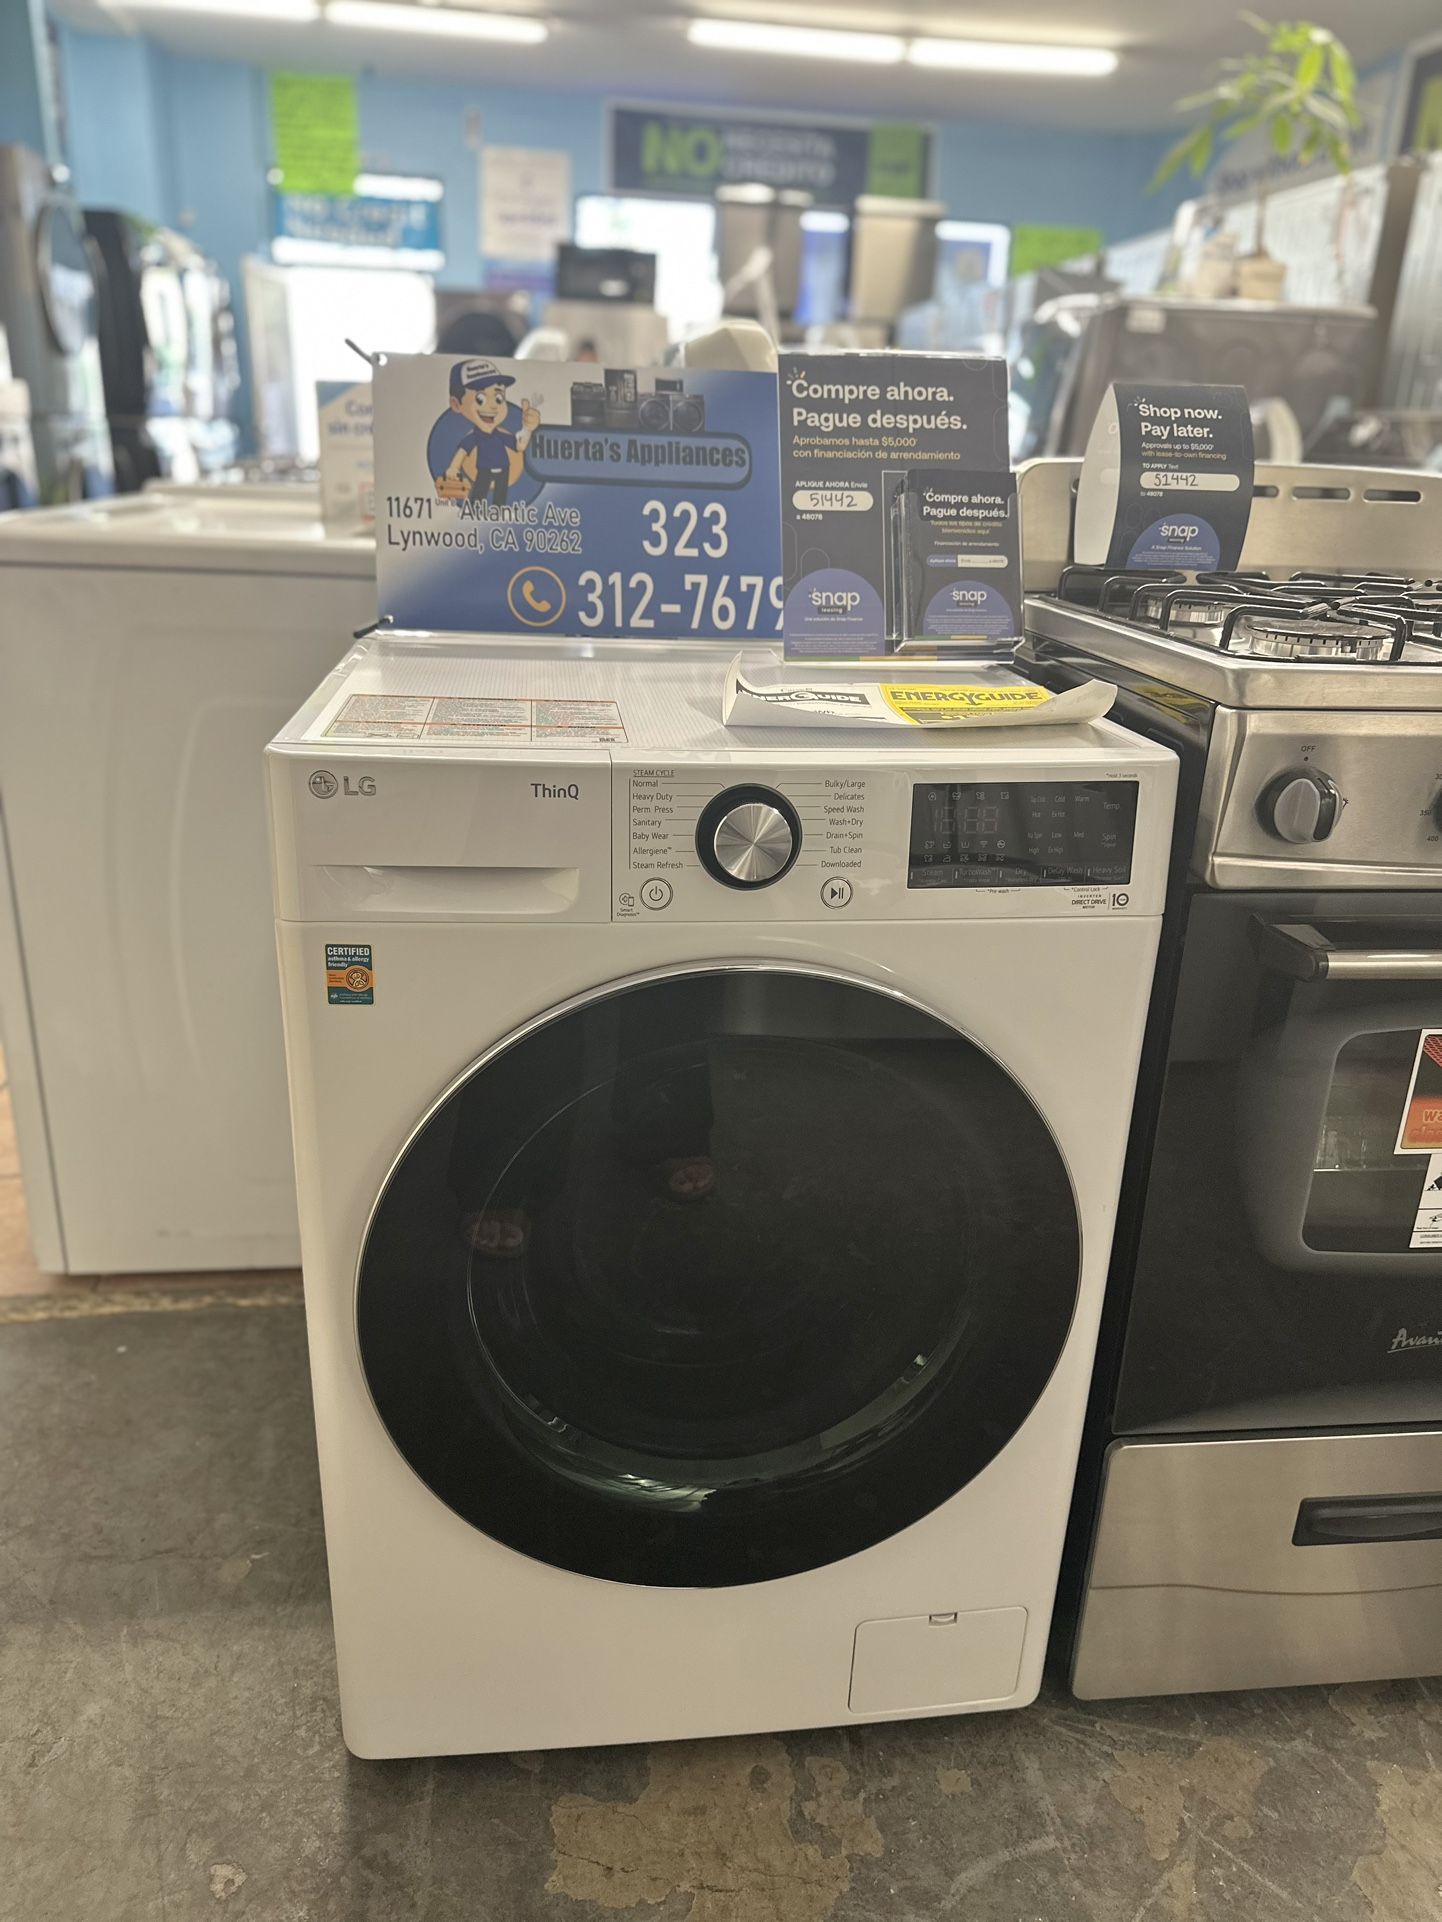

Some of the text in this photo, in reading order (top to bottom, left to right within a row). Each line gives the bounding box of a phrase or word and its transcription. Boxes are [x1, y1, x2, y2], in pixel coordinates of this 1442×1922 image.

[642, 121, 722, 177] NO
[791, 378, 955, 404] Compre ahora.
[1138, 404, 1222, 420] Shop now.
[792, 408, 968, 433] Pague después.
[1140, 422, 1213, 439] Pay later.
[792, 435, 850, 447] Aprobamos
[852, 436, 880, 446] hasta
[1141, 442, 1172, 450] Approvals
[532, 434, 748, 468] Huerta's Appliances
[793, 448, 961, 461] con financiación de arrendamiento
[1198, 452, 1226, 460] financing
[795, 480, 824, 488] APLIQUE
[825, 480, 850, 488] AHORA
[1154, 473, 1199, 487] 51442
[809, 492, 858, 508] 51442
[925, 492, 1005, 505] Compre ahora.
[386, 496, 432, 520] 11671
[459, 501, 538, 526] Atlantic
[542, 504, 580, 527] Ave
[923, 506, 1008, 520] Pague después.
[642, 500, 729, 559] 323
[1160, 524, 1198, 541] snap
[387, 524, 582, 554] Lynwood, CA 90262
[577, 570, 783, 631] 312-7679
[811, 590, 860, 612] snap
[952, 590, 987, 606] snap
[890, 691, 1043, 706] ENERGYGUIDE
[343, 776, 376, 797] LG
[632, 780, 658, 788] Normal
[824, 780, 866, 790] Bulky/Large
[530, 783, 580, 800] ThinQ
[632, 792, 673, 802] Heavy Duty
[834, 792, 865, 800] Delicates
[654, 806, 674, 814] Press
[824, 805, 864, 814] Speed Wash
[1104, 802, 1120, 812] Temp
[632, 818, 662, 828] Sanitary
[828, 818, 864, 828] Wash+Dry
[632, 832, 669, 841] Baby Wear
[826, 832, 864, 840] Drain+Spin
[1102, 833, 1117, 842] Spin
[632, 862, 684, 870] Steam Refresh
[821, 860, 862, 868] Downloaded
[1112, 893, 1130, 907] 10
[328, 946, 370, 956] CERTIFIED
